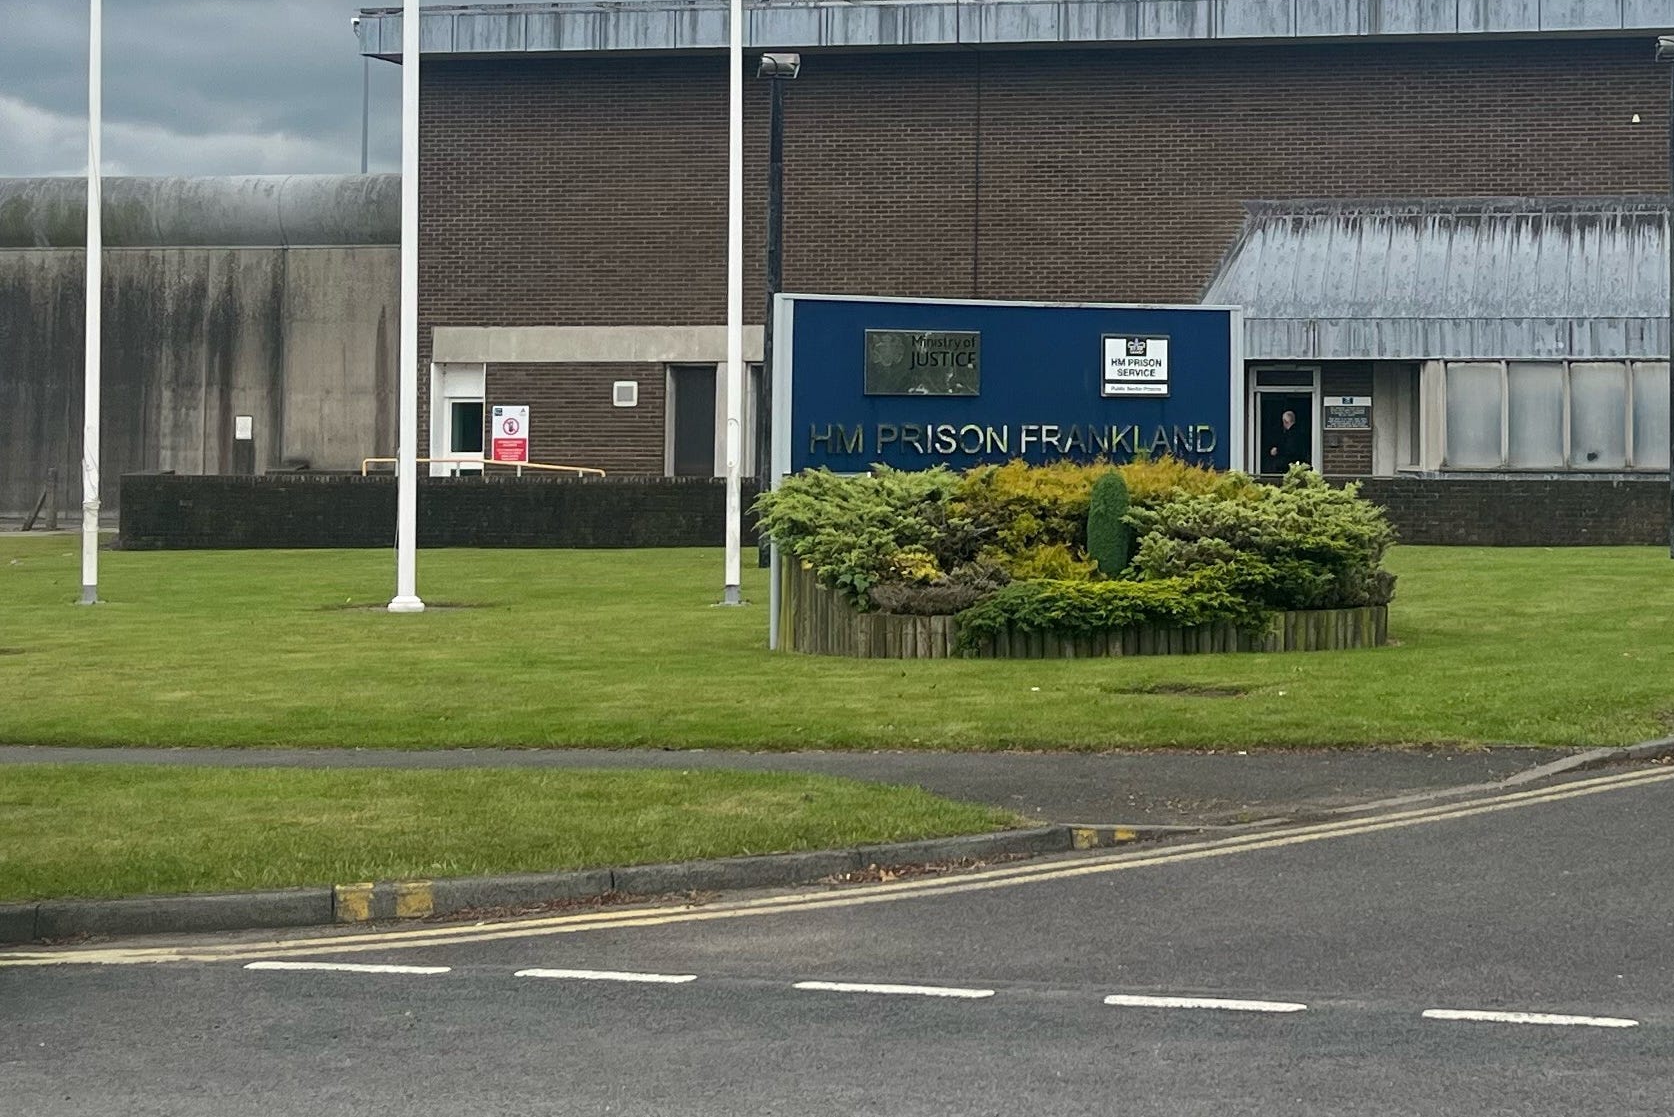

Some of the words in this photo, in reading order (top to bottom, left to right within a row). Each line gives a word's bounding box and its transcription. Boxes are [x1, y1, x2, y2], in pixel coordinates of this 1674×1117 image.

[911, 335, 960, 351] Ministry
[963, 336, 976, 348] of
[909, 351, 976, 370] JUSTICE
[1111, 358, 1126, 367] HM
[1127, 358, 1162, 367] PRISON
[1116, 368, 1156, 377] SERVICE
[810, 423, 864, 454] HM
[876, 423, 1009, 455] PRISON
[1020, 423, 1217, 455] FRANKLAND
